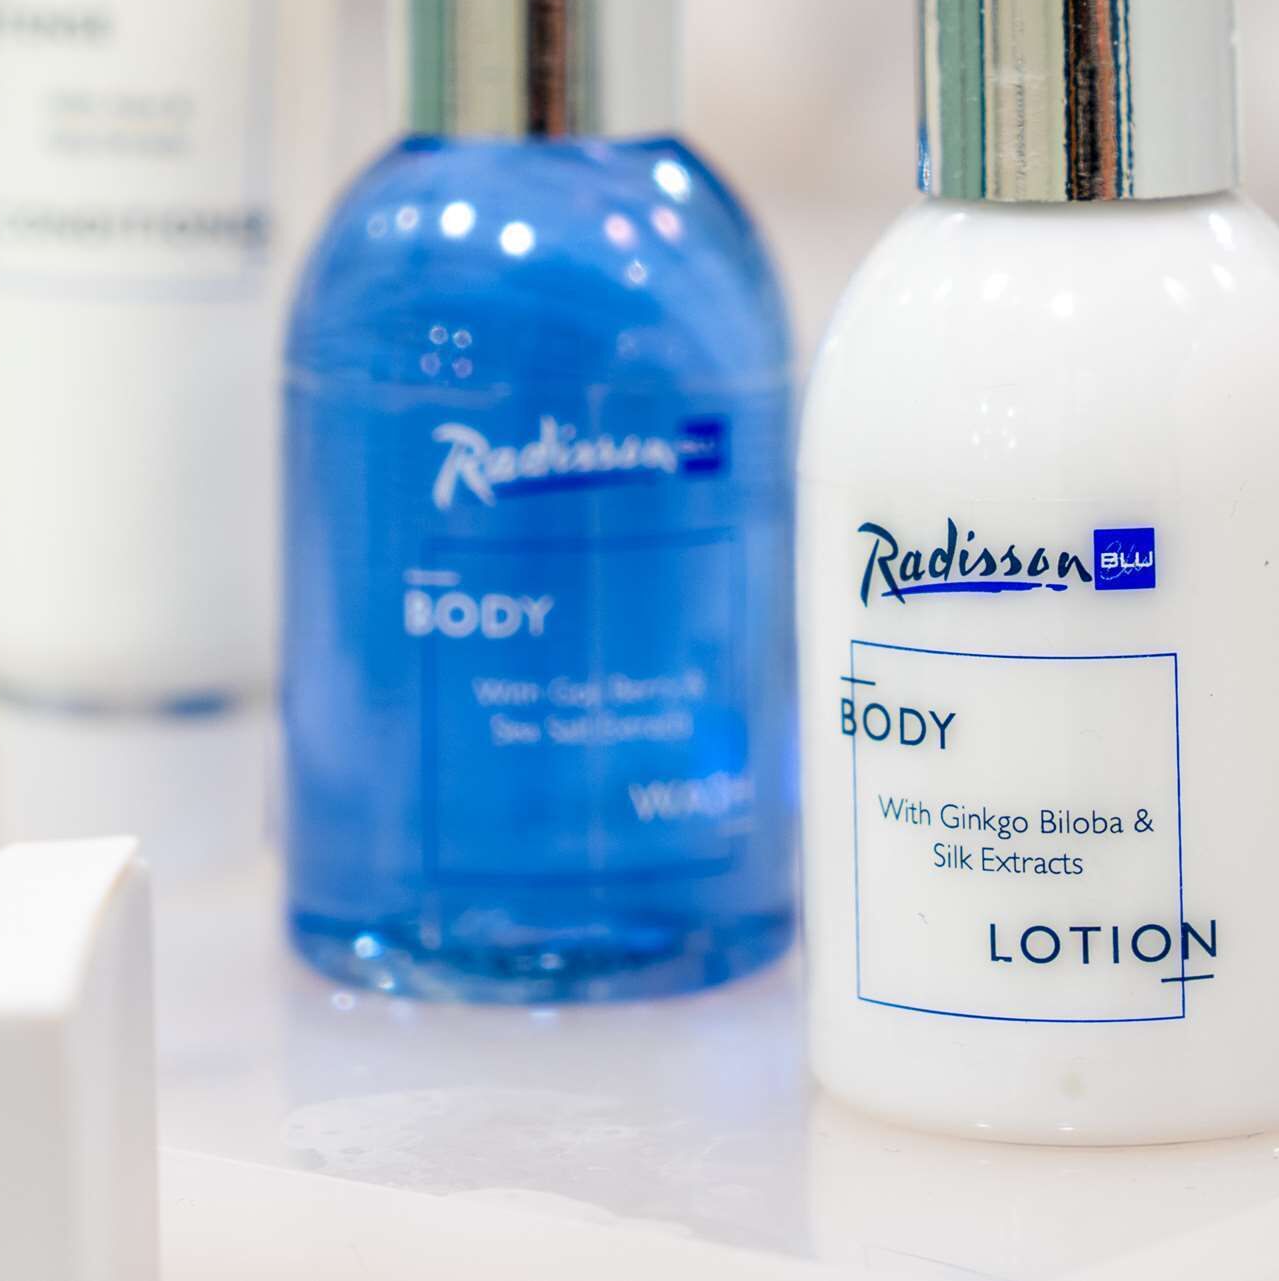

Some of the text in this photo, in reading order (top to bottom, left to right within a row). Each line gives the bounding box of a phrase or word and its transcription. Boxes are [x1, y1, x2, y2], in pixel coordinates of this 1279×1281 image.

[431, 414, 677, 510] Radisson
[857, 517, 1093, 608] Radisson
[404, 589, 554, 639] BODY
[840, 696, 957, 750] BODY
[878, 793, 1155, 841] With Ginkgo Biloba &
[933, 842, 1084, 875] Silk Extracts
[989, 919, 1218, 965] LOTION
